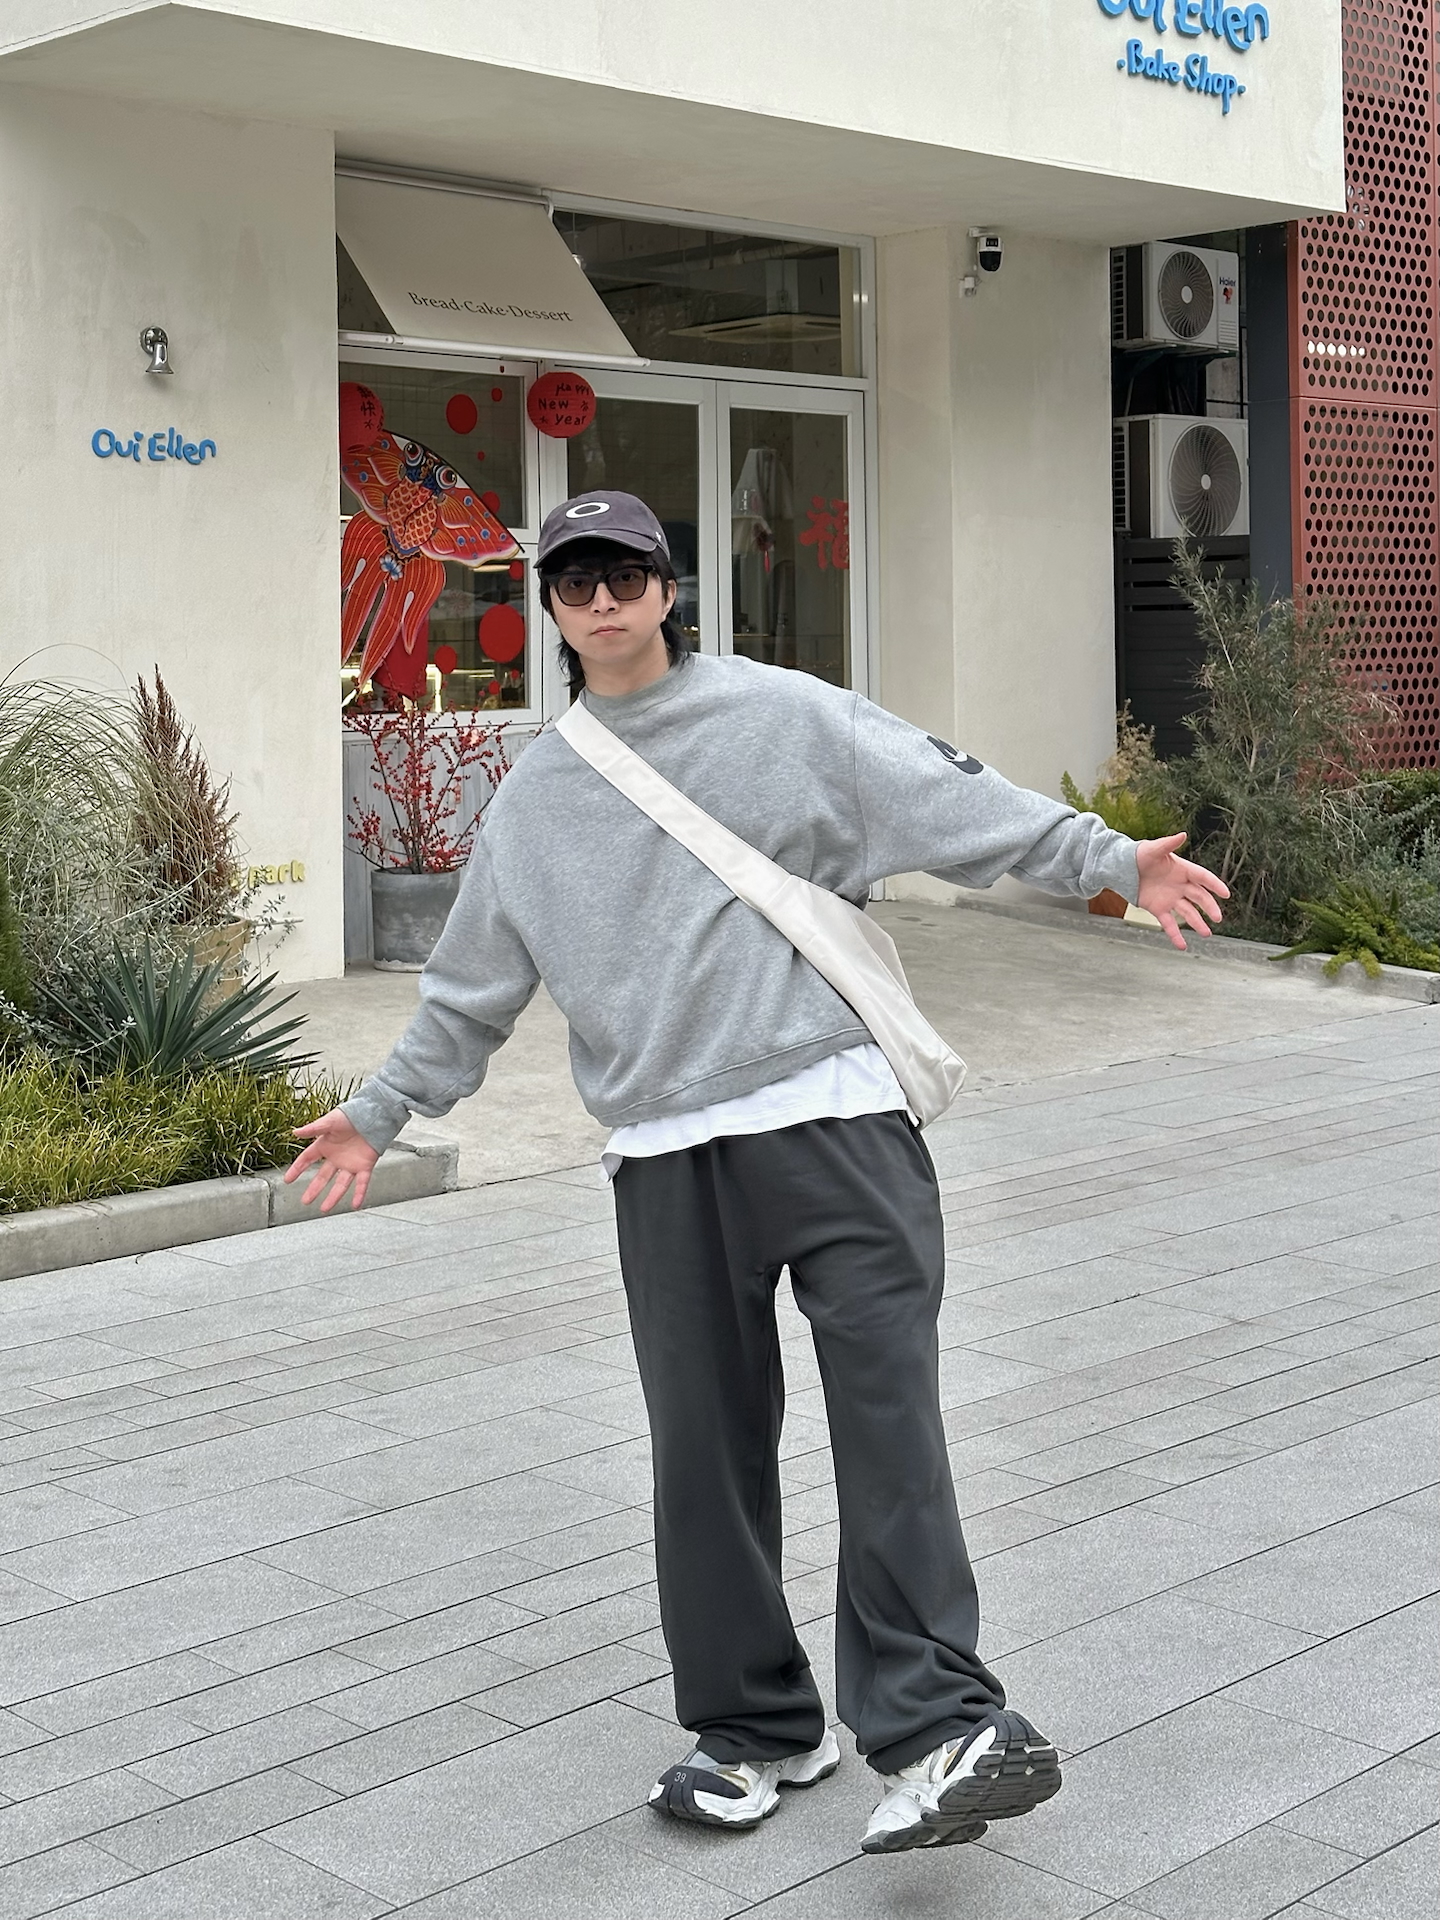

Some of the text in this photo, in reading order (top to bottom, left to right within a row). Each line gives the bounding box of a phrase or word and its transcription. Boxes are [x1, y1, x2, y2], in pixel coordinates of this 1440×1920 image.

[538, 397, 569, 411] New
[91, 427, 217, 465] Oui Ellen
